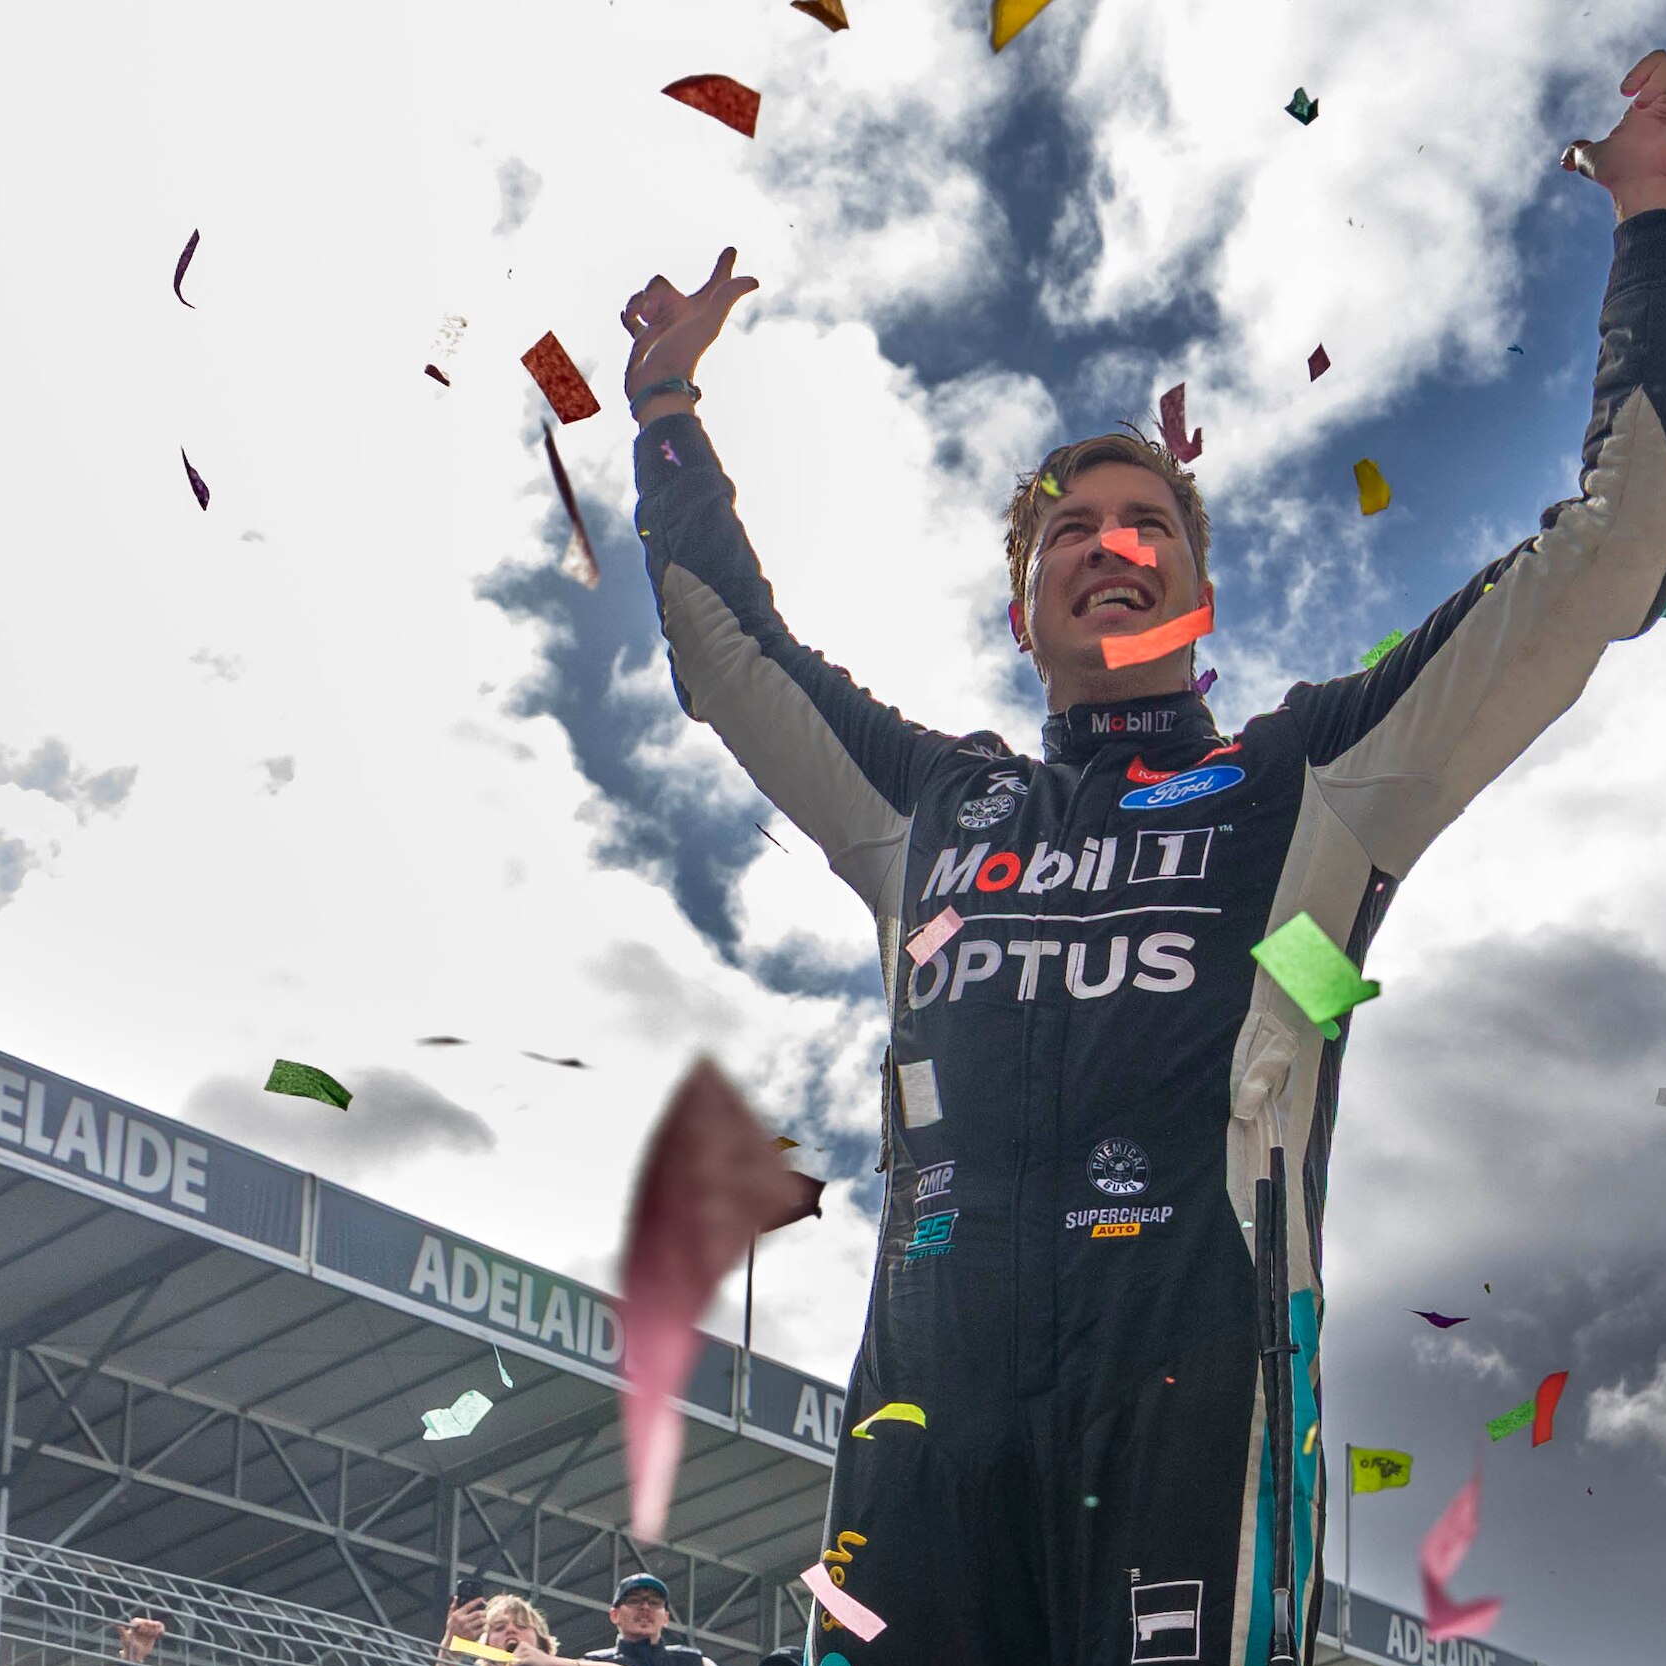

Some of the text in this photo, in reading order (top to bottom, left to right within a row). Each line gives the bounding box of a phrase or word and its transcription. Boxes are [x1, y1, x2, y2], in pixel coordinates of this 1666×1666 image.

[1091, 713, 1152, 733] Mobil
[1146, 773, 1215, 806] Ford
[921, 836, 1118, 902] Mobil
[1157, 835, 1184, 876] 1
[908, 932, 1196, 1011] OPTUS
[917, 1166, 954, 1197] OMP
[1065, 1206, 1173, 1229] SUPERCHEAP
[1097, 1225, 1135, 1235] AUTO
[408, 1235, 626, 1368] ADELAID
